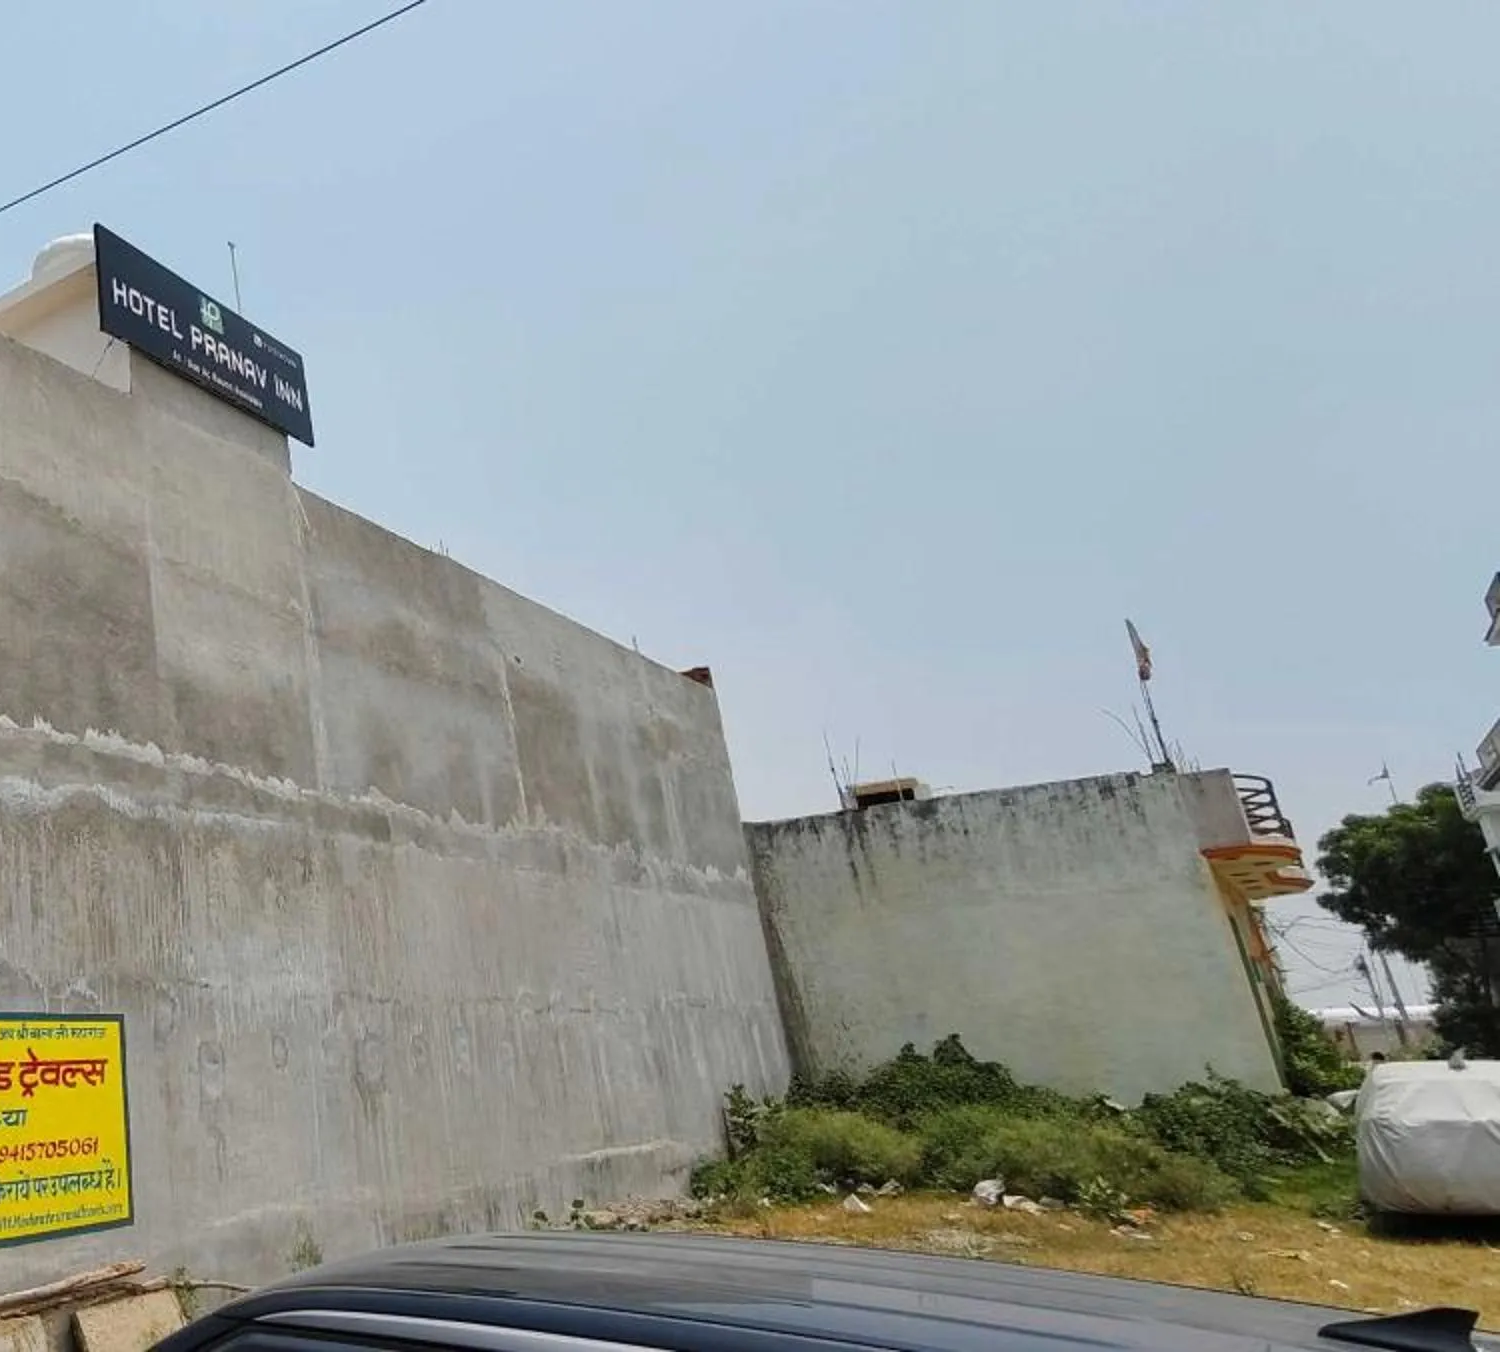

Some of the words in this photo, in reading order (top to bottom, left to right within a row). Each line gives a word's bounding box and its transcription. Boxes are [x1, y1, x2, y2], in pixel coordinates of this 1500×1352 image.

[112, 277, 183, 340] HOTEL
[190, 325, 267, 389] PRANAV
[273, 373, 303, 412] INN
[19, 1047, 108, 1097] ट्रेवल्स
